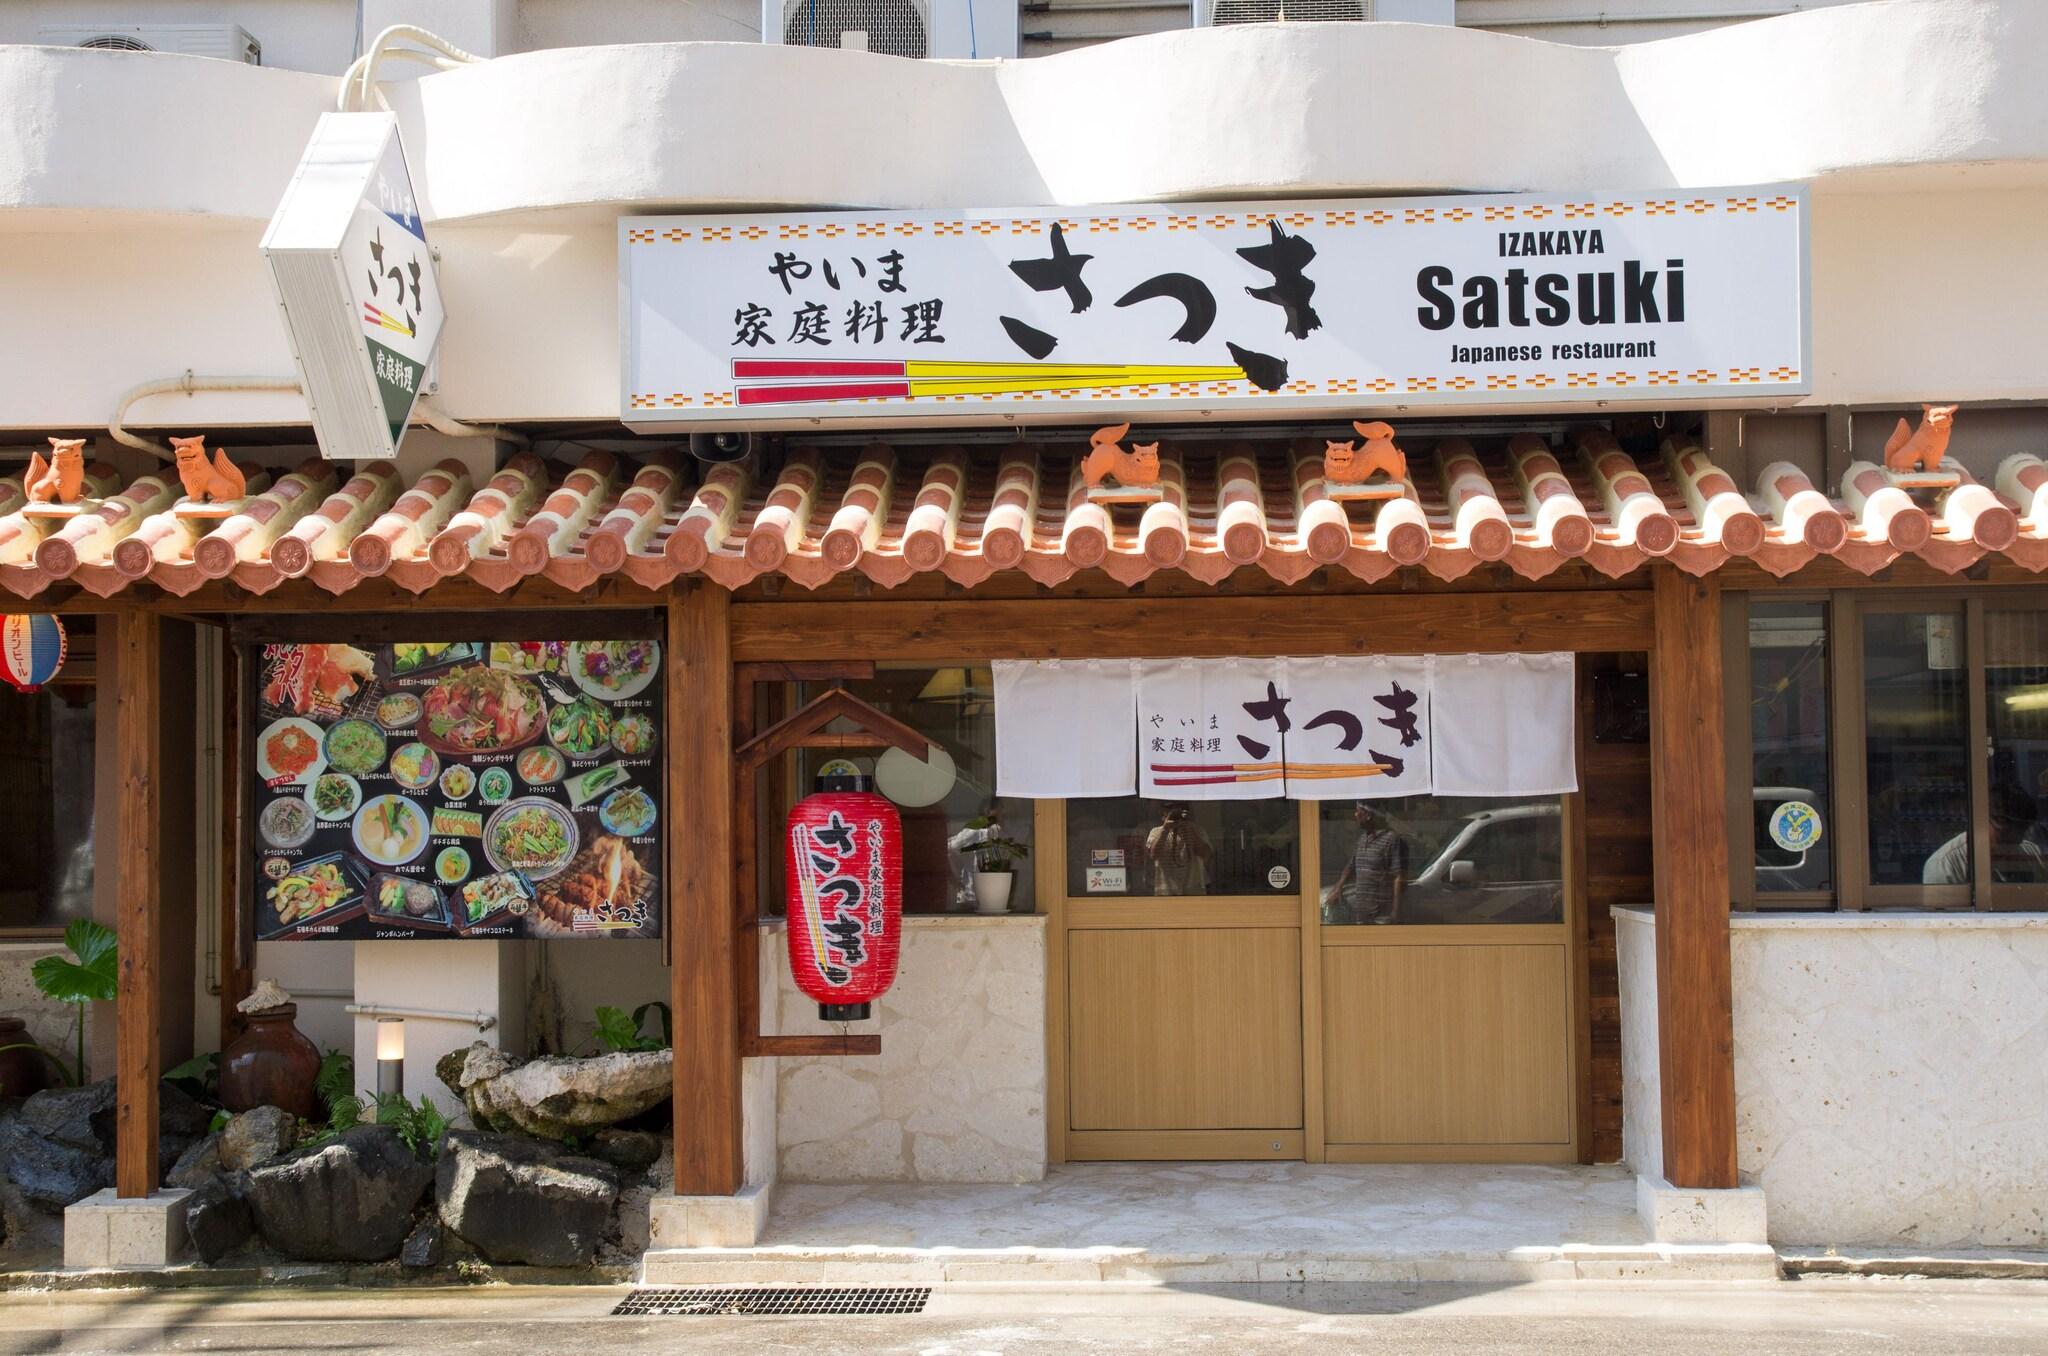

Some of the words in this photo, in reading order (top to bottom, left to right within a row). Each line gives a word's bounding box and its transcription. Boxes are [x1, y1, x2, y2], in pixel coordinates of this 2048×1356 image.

[1499, 229, 1605, 257] IZAKAYA
[368, 225, 421, 339] さつき
[769, 249, 907, 295] やいま
[1416, 258, 1686, 331] Satsuki
[733, 299, 946, 348] 家庭料理
[1000, 221, 1324, 395] さつき
[375, 349, 415, 394] 家庭料理
[1450, 344, 1543, 365] Japanese
[1552, 340, 1657, 360] restaurant
[1150, 709, 1219, 732] やいま
[1238, 682, 1422, 779] さつき
[1151, 737, 1222, 757] 家庭料理
[811, 811, 868, 987] さつき
[867, 818, 886, 937] やいま家庭料理
[376, 930, 415, 938] ジャンボハンバーグ
[597, 899, 648, 928] さつき
